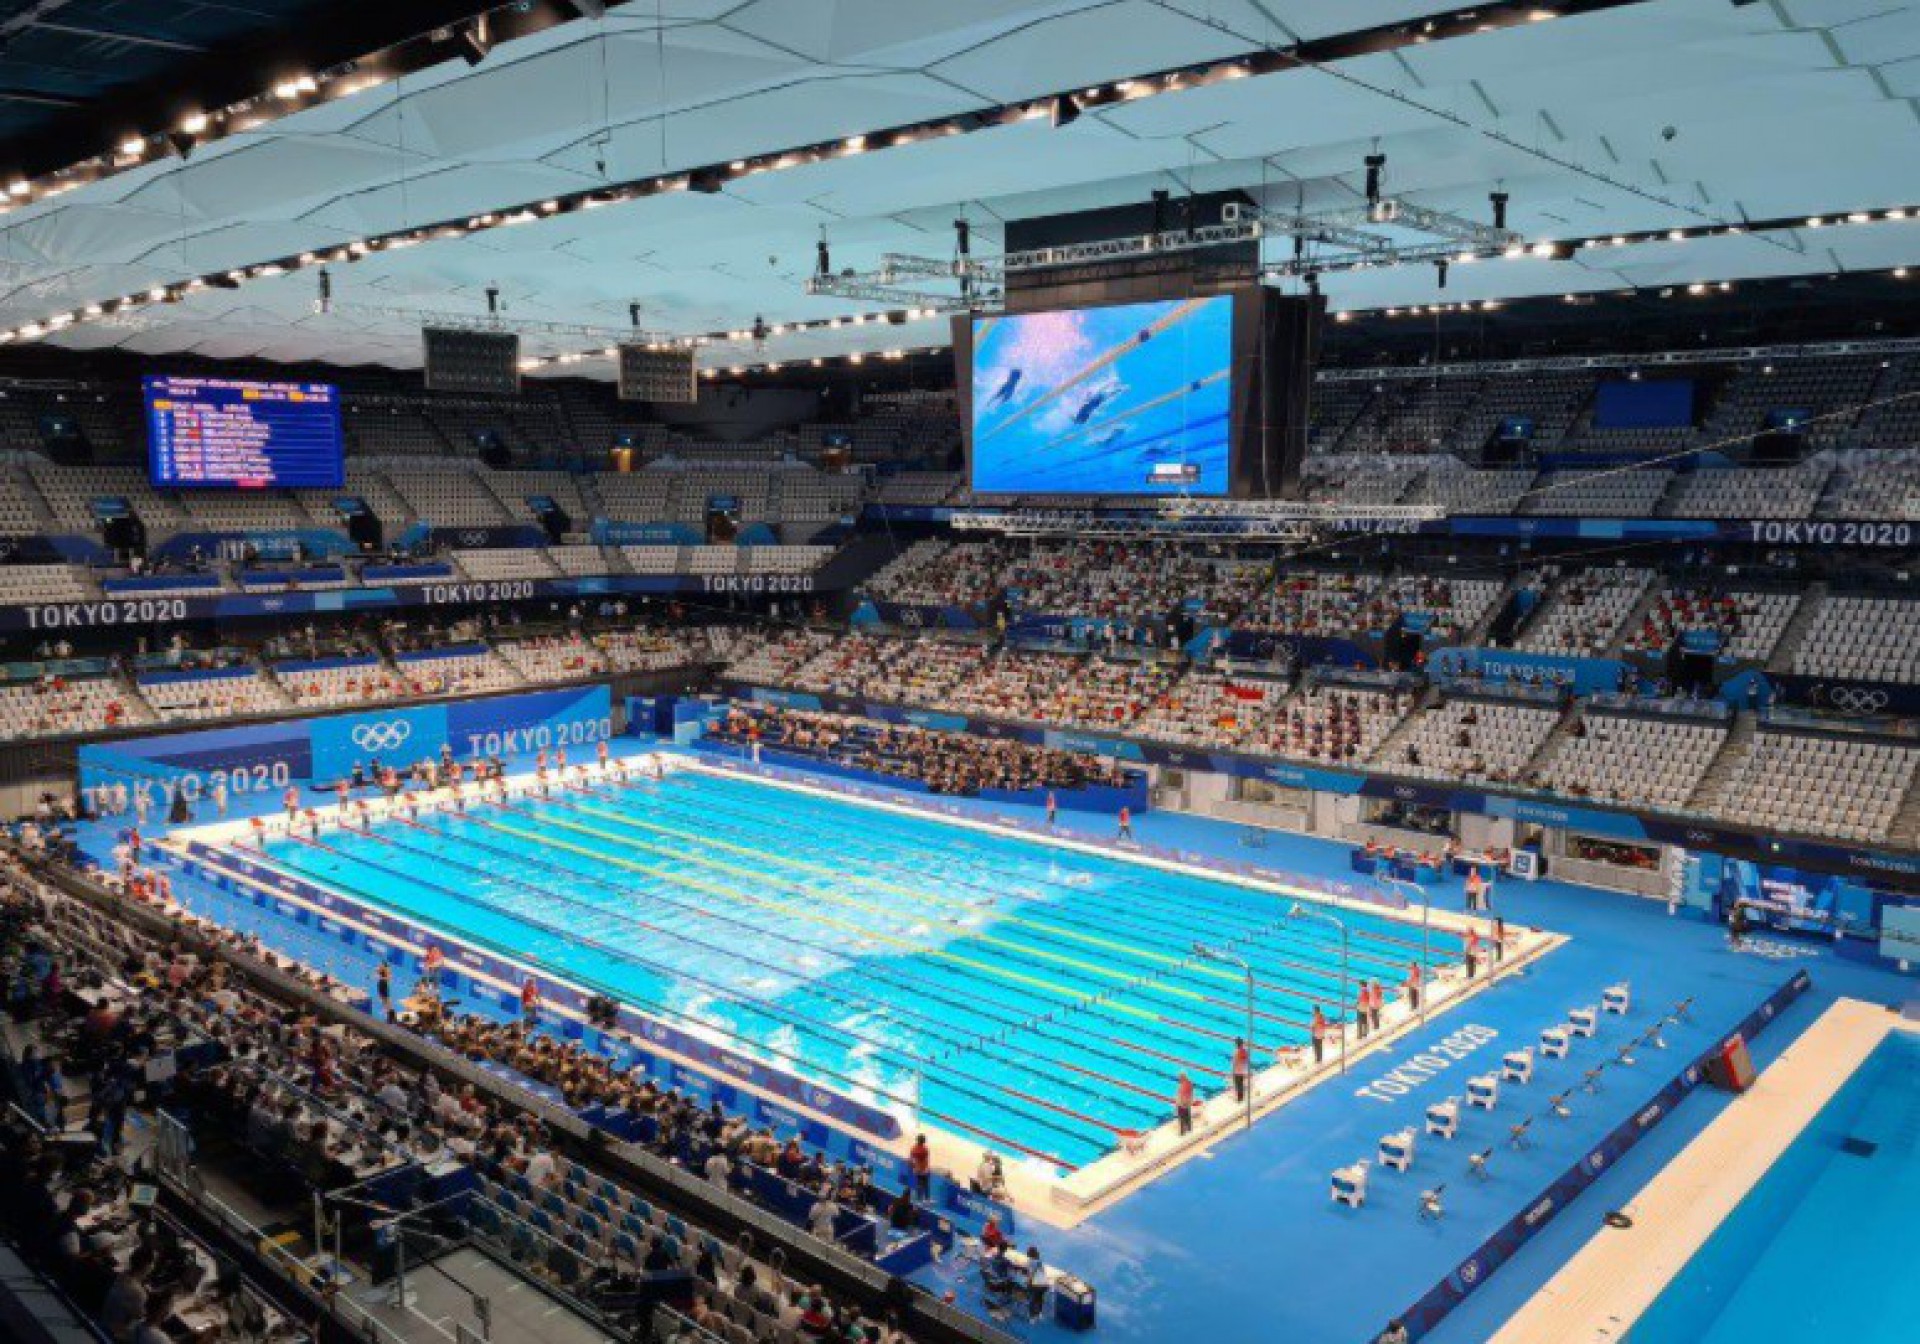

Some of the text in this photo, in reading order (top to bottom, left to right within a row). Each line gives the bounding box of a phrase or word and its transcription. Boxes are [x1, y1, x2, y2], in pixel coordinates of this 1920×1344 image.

[1750, 521, 1911, 546] TOKYO 2020
[421, 579, 534, 605] TOKYO 2020
[702, 574, 815, 593] TOKYO 2020
[24, 599, 187, 628] TOKYO 2020
[469, 718, 611, 757] TOKYO 2020
[211, 761, 289, 798] 2020
[1355, 1024, 1499, 1102] TOKYO 2020
